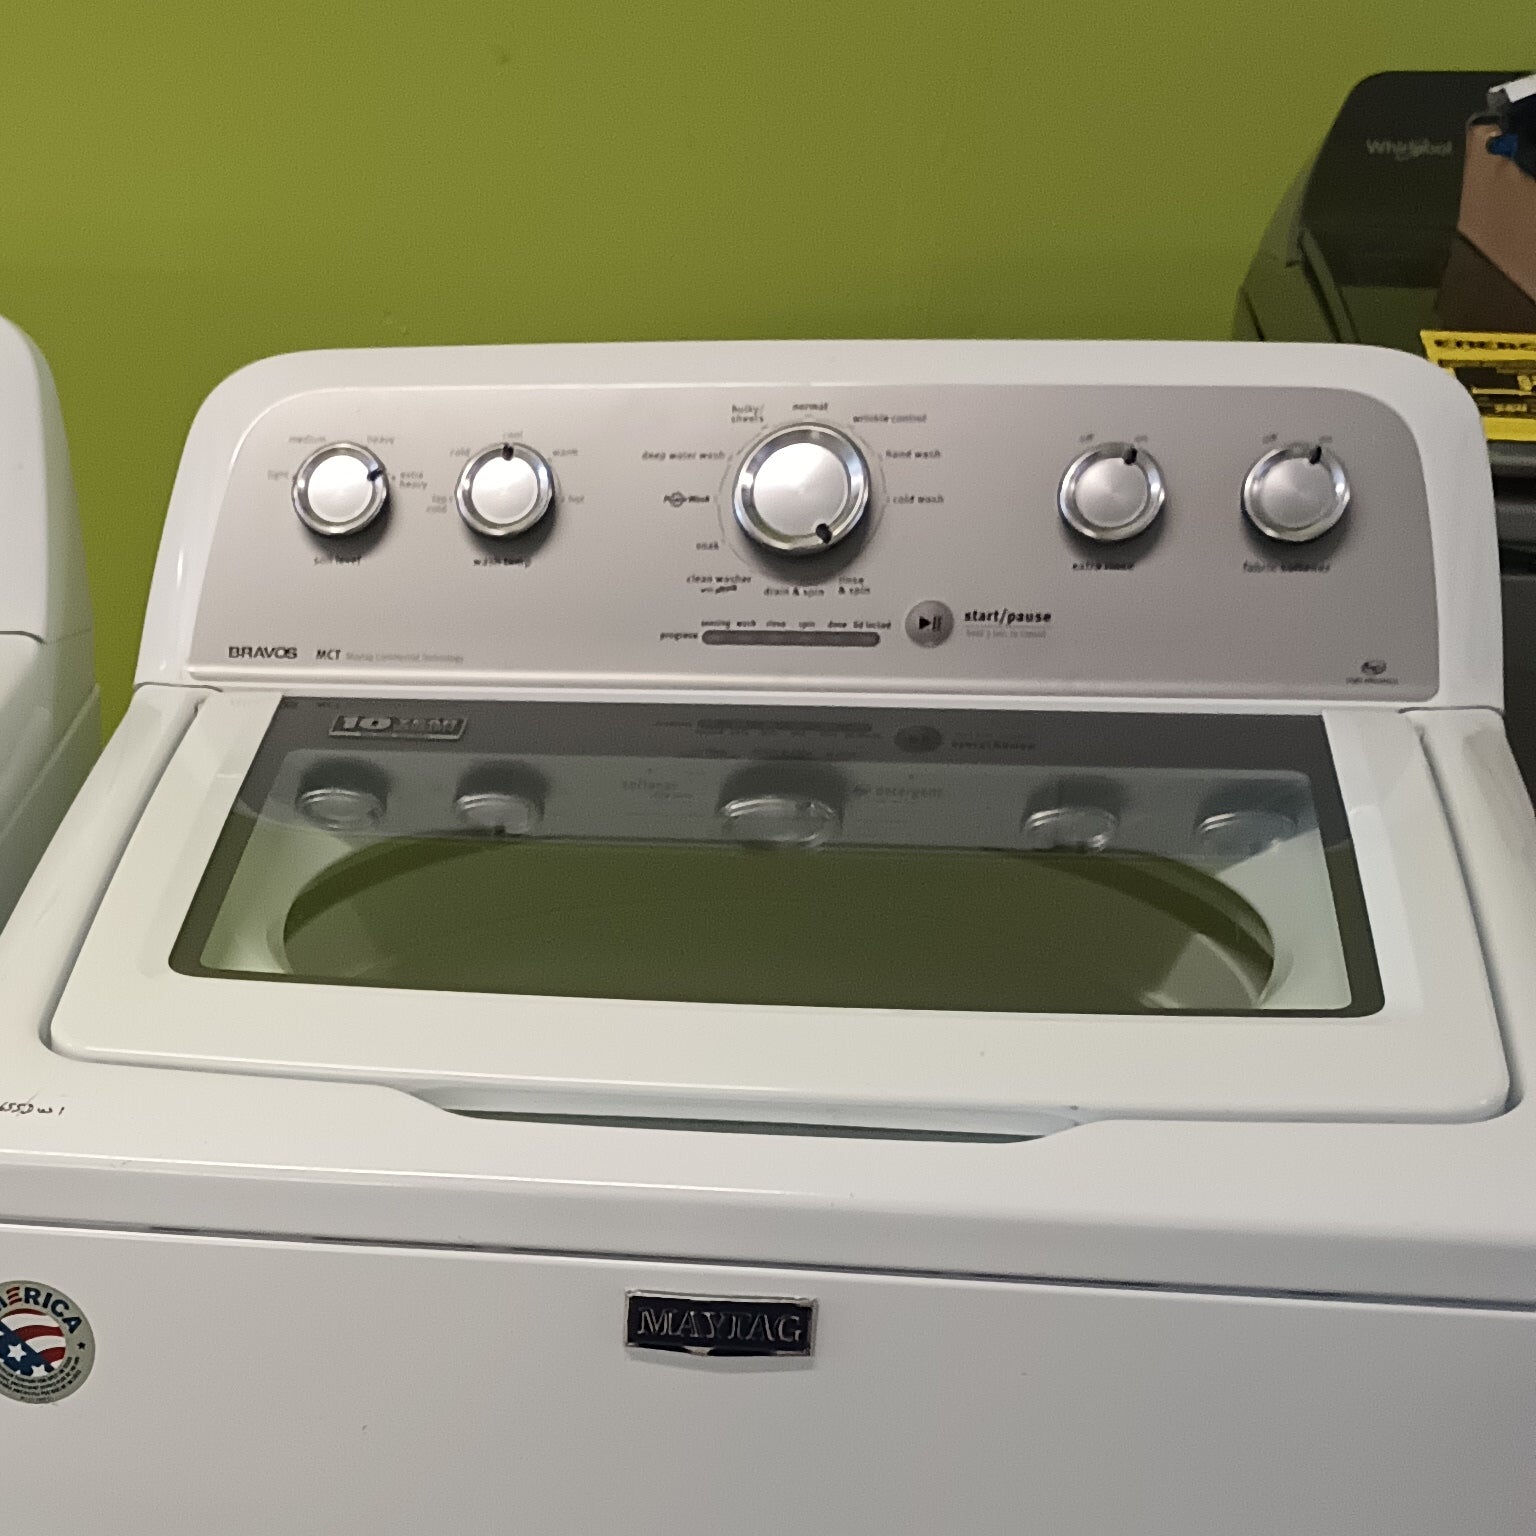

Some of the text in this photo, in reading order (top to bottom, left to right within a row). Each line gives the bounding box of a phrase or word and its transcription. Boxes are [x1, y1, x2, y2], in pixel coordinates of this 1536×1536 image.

[964, 607, 1052, 627] start/pause
[228, 646, 298, 660] BRAVOS
[636, 1306, 803, 1343] MAYTAG
